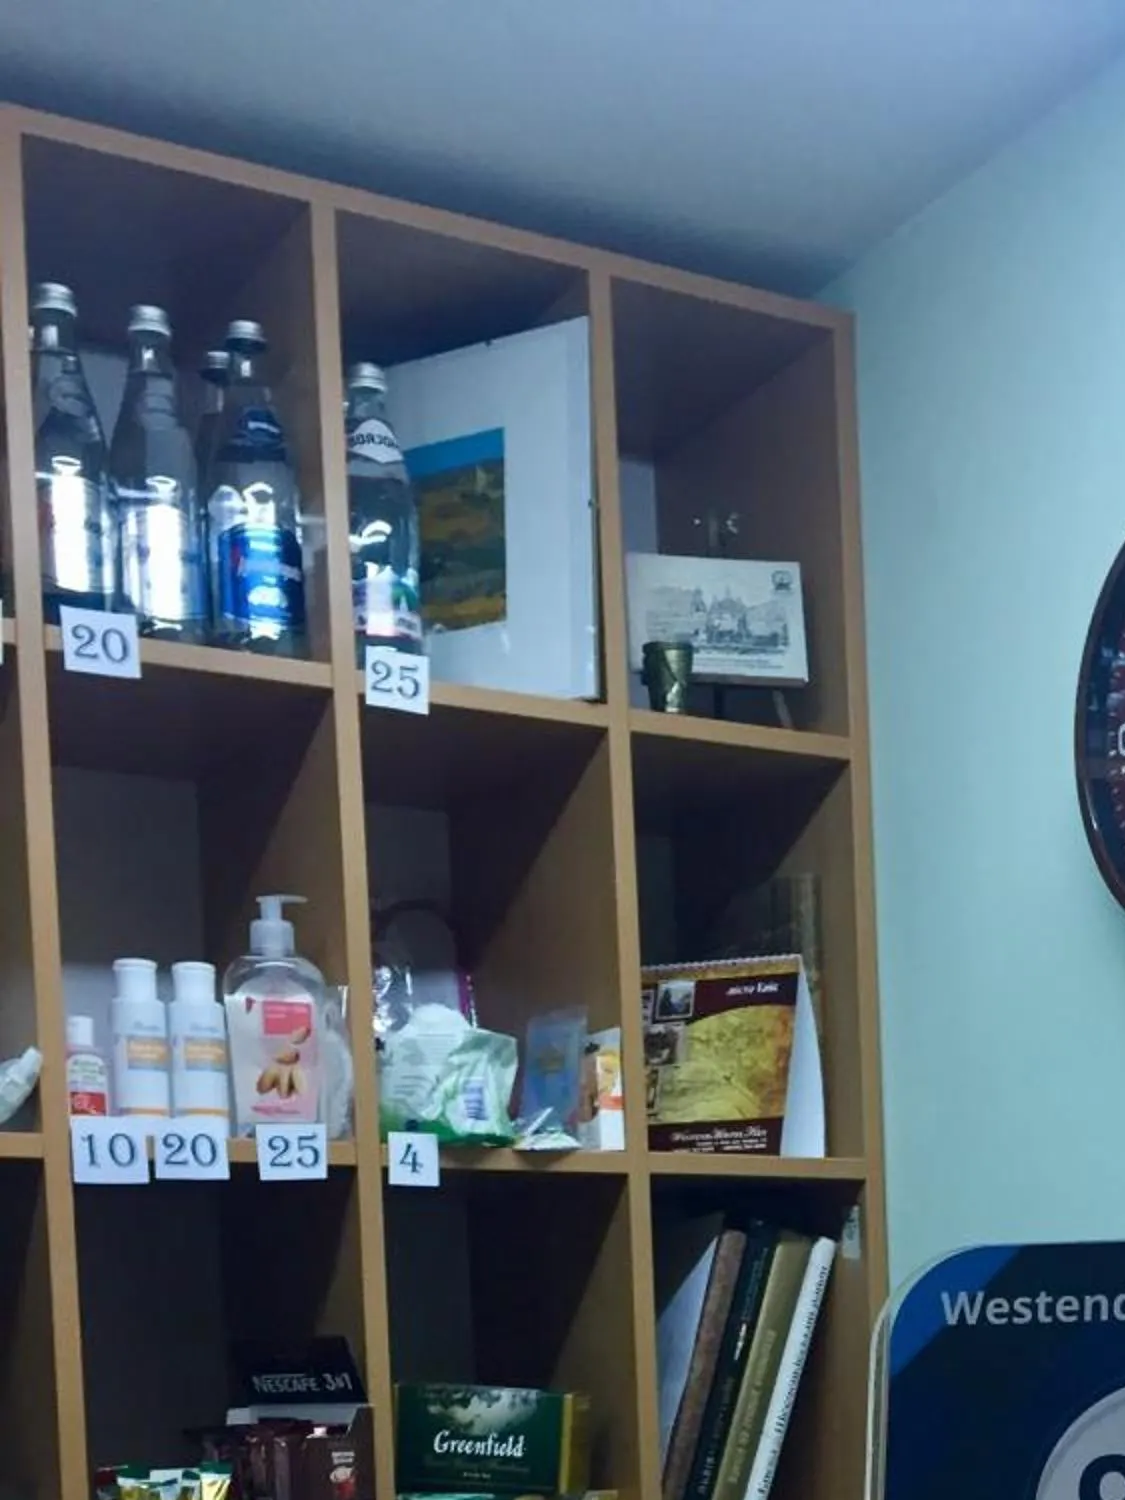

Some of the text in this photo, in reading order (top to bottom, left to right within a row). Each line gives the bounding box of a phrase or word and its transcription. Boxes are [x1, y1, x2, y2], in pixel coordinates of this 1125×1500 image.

[71, 623, 130, 664] 20
[370, 659, 421, 700] 25
[81, 1133, 136, 1169] 10
[161, 1133, 218, 1168] 20
[267, 1133, 320, 1168] 25
[399, 1143, 423, 1173] 4
[433, 1429, 526, 1457] Greenfield
